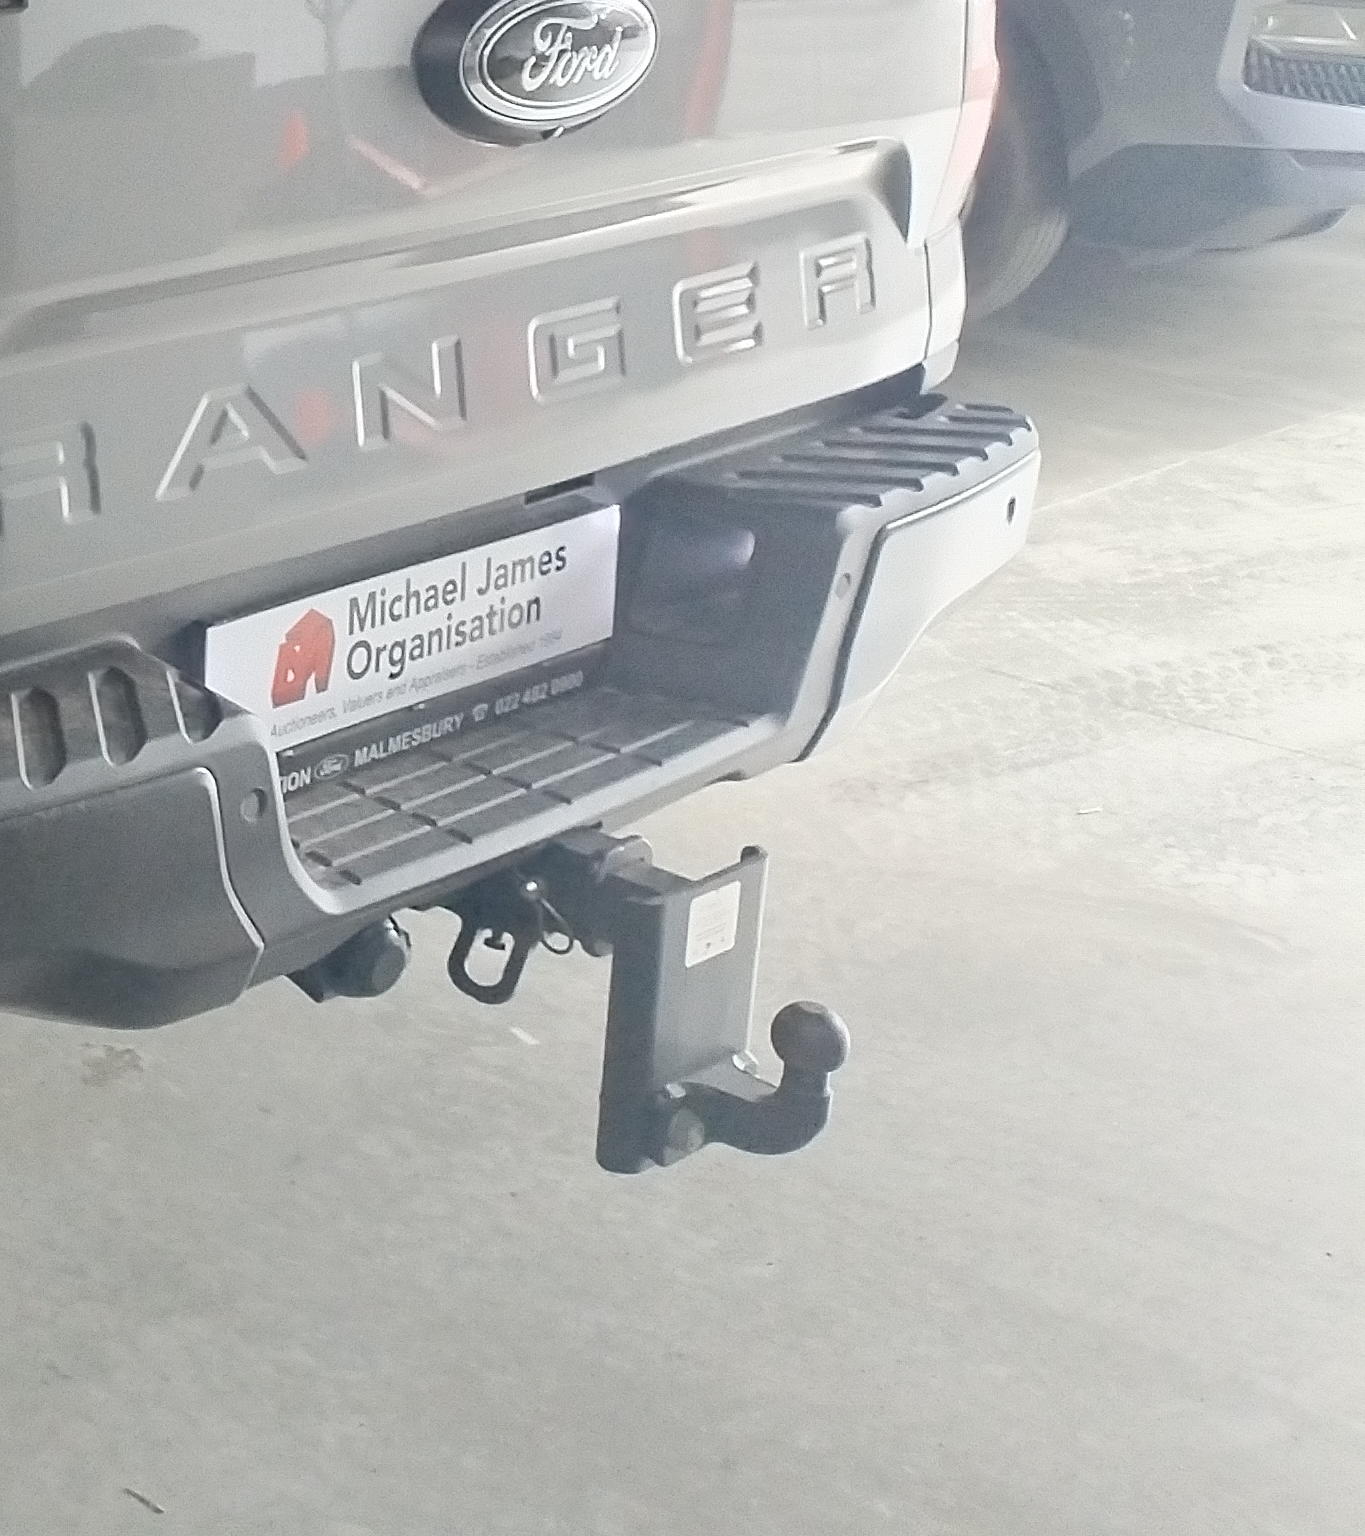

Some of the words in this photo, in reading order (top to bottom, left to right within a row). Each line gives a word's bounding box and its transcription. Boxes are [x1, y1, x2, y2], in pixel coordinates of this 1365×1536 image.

[521, 16, 625, 92] Ford
[348, 560, 468, 636] Michael
[476, 543, 567, 597] James
[346, 595, 542, 681] Organisation
[354, 712, 464, 767] MALMESBURY
